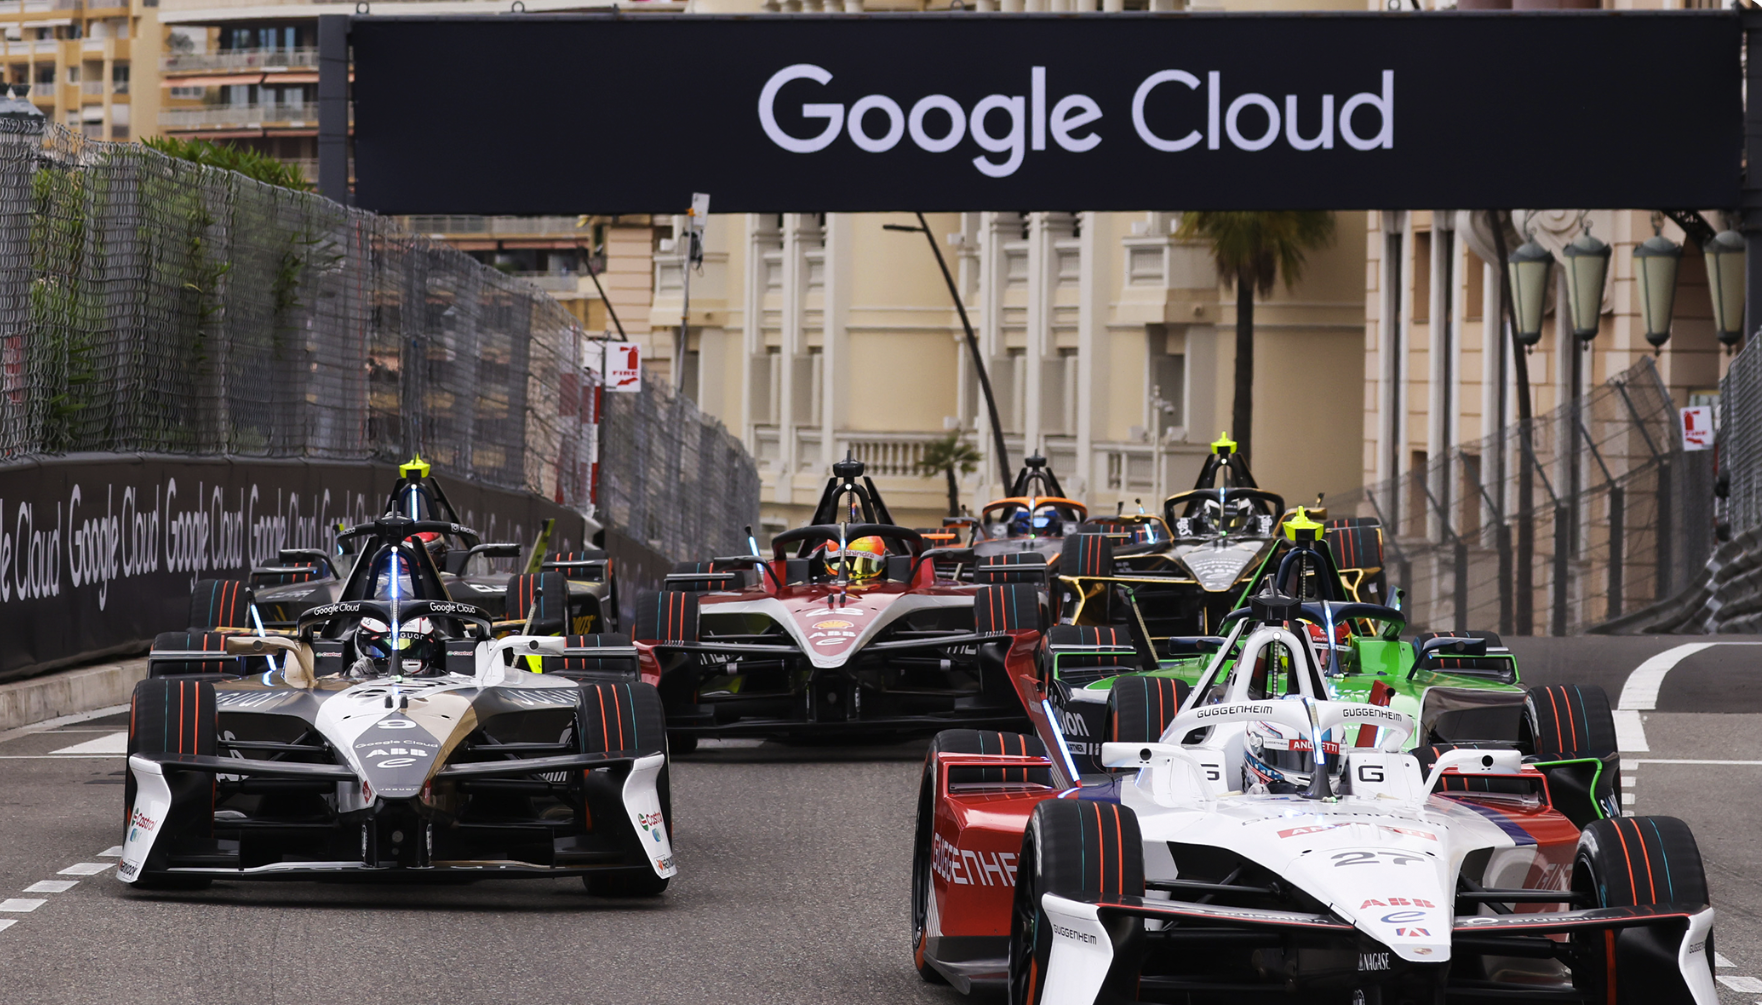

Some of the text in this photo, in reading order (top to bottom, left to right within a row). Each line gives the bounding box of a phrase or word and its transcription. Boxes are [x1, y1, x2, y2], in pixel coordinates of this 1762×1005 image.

[757, 63, 1394, 178] Google Cloud
[14, 501, 61, 601] Cloud
[69, 483, 119, 612] Google
[121, 484, 160, 578] Cloud
[165, 477, 209, 593] Google
[211, 485, 244, 571] Cloud
[314, 602, 361, 616] Google Cloud
[430, 602, 476, 614] Google Cloud
[808, 630, 857, 639] ABB
[1197, 704, 1273, 719] GUGGENHEIM
[1342, 708, 1403, 722] GUGGENHEIM
[377, 719, 417, 729] 9
[355, 739, 439, 749] Google Cloud
[365, 748, 429, 758] ABB
[1358, 765, 1385, 783] G
[932, 832, 1020, 887] GUGGENHE
[1330, 851, 1426, 867] 27
[1359, 897, 1436, 910] ABB
[1053, 923, 1098, 946] GUGGENHEIM
[1363, 952, 1391, 971] NAGASE
